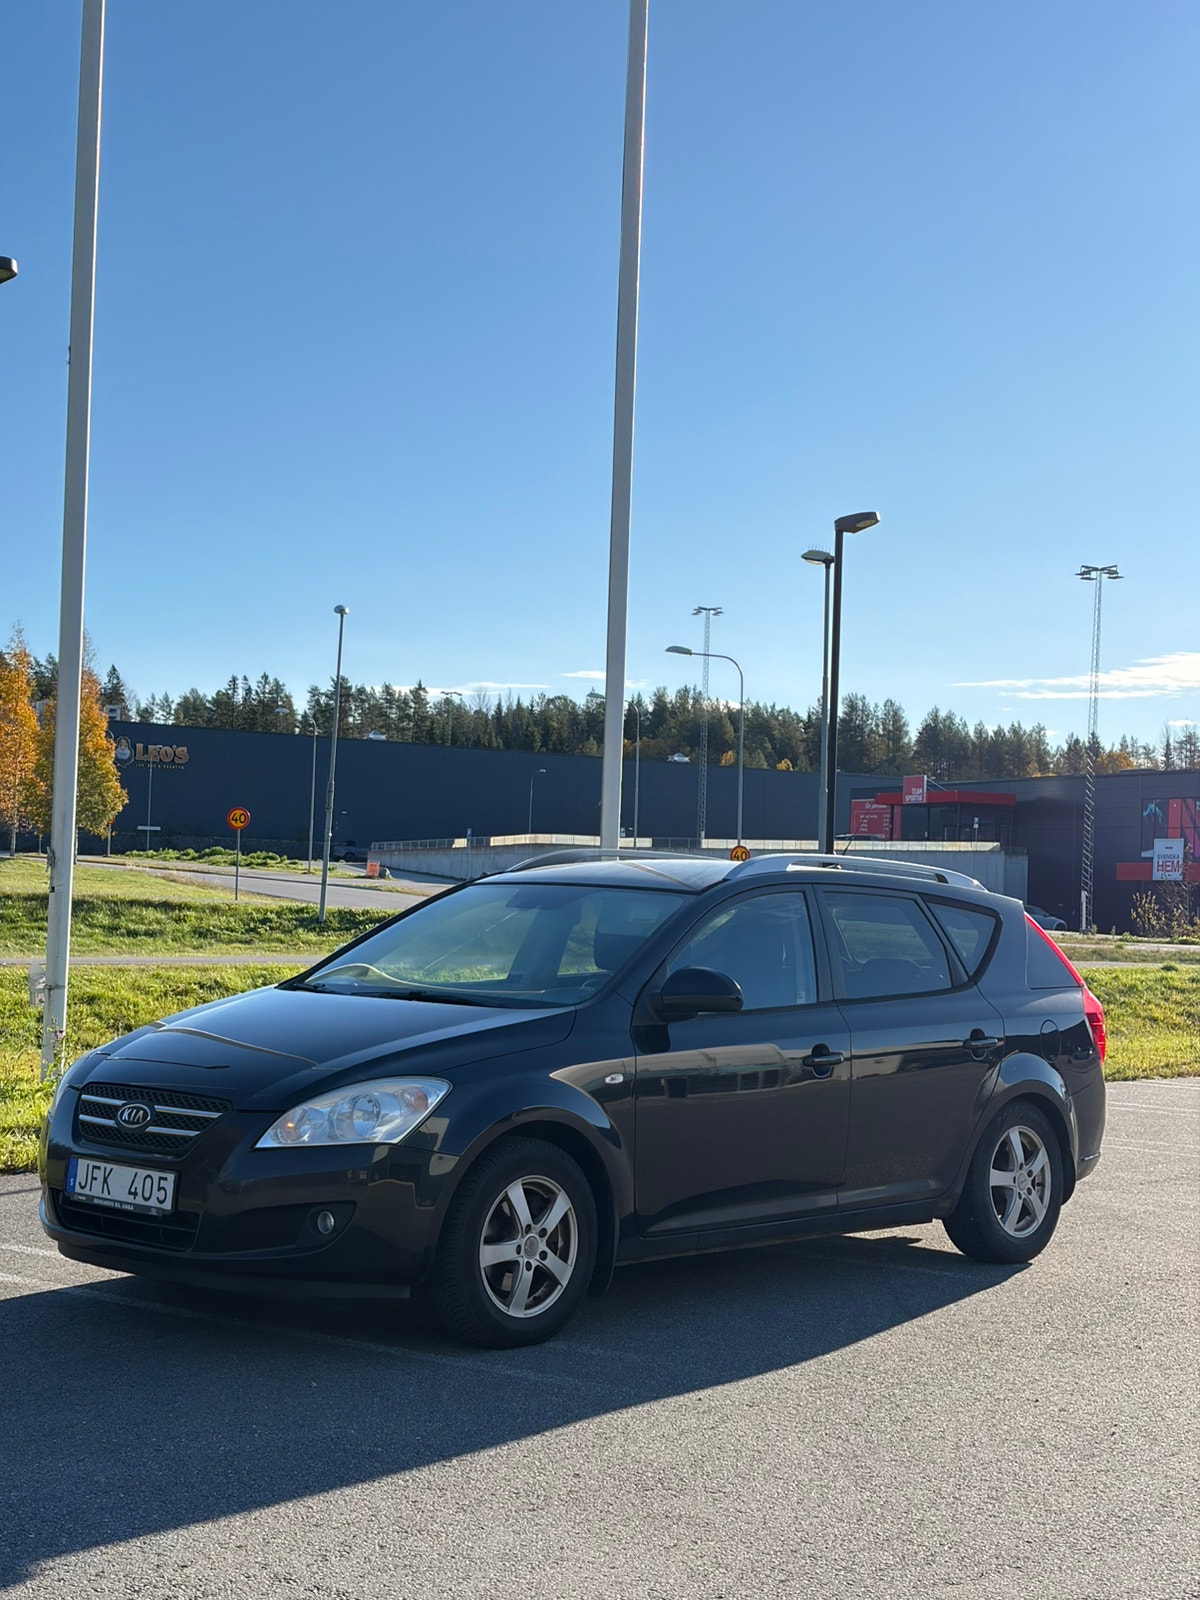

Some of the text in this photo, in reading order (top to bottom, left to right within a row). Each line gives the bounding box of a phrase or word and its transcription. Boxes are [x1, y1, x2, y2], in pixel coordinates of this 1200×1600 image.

[136, 743, 190, 764] LEO'S
[231, 812, 247, 824] 40
[733, 850, 748, 861] 40
[1156, 860, 1180, 873] HEM
[122, 1107, 144, 1123] KIA
[78, 1163, 168, 1205] JFK 405
